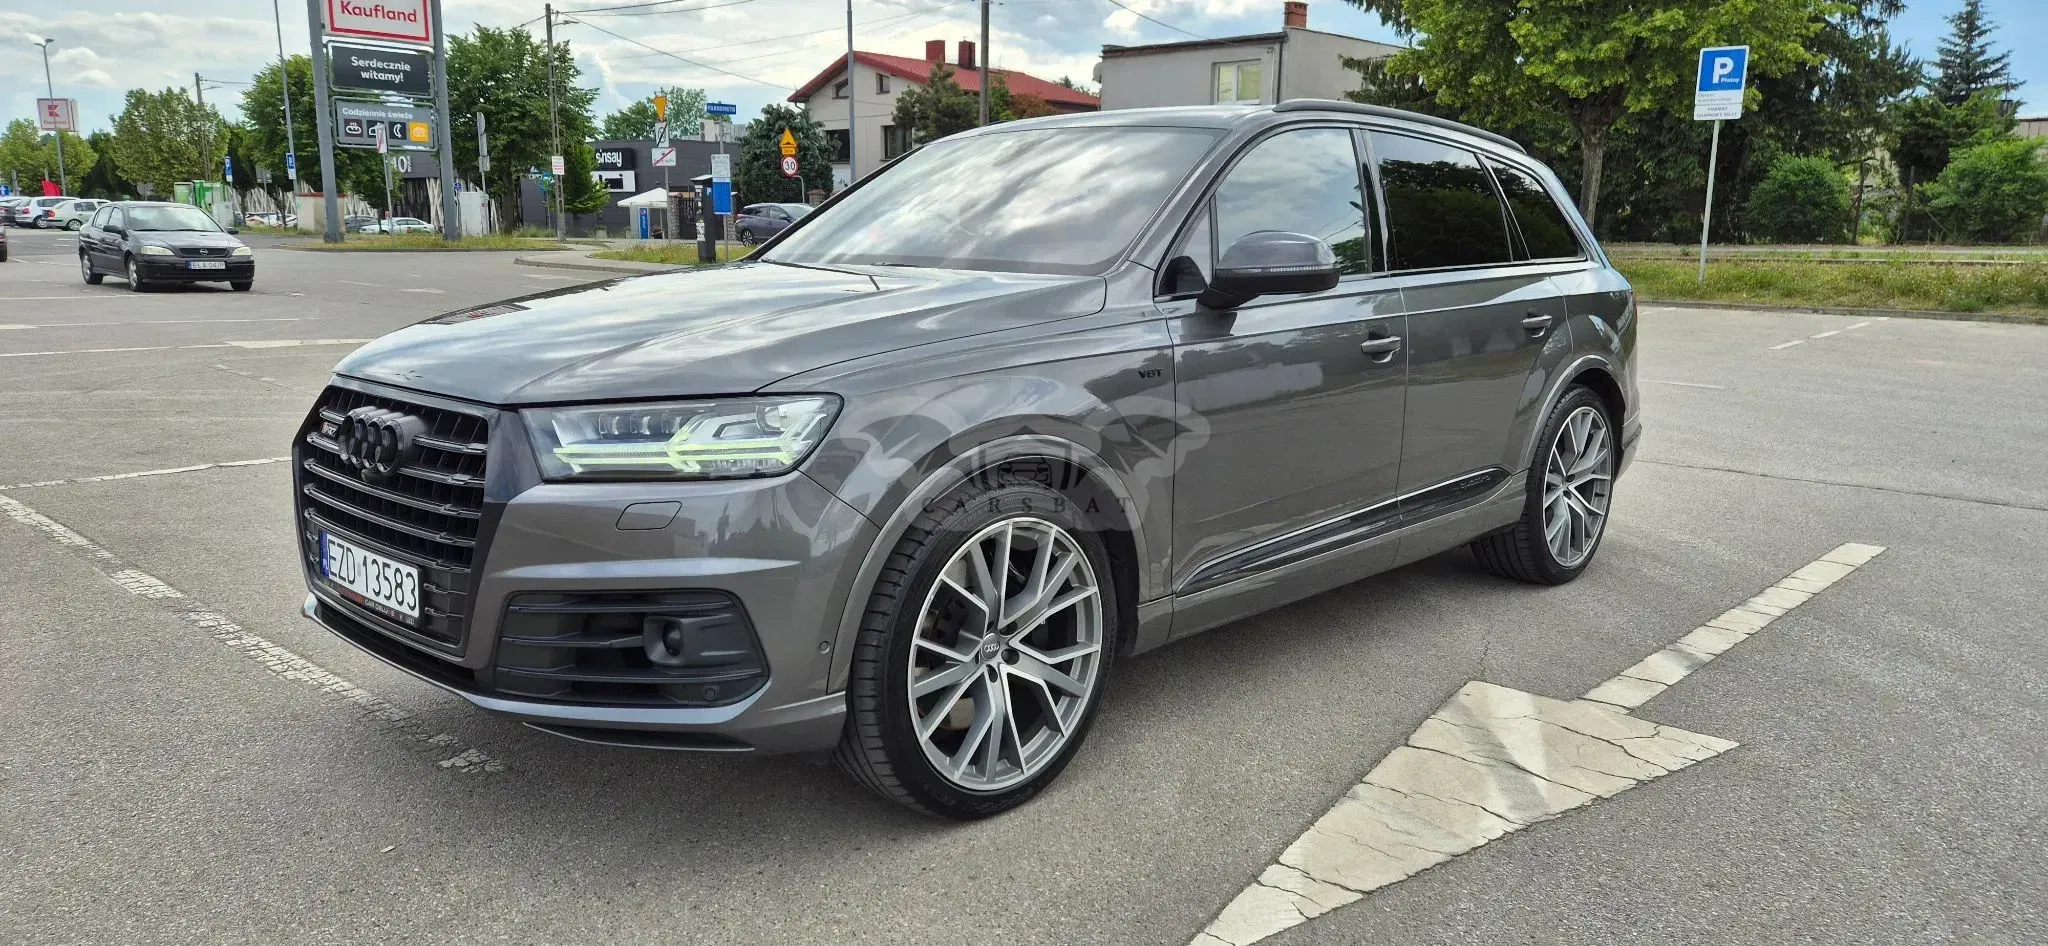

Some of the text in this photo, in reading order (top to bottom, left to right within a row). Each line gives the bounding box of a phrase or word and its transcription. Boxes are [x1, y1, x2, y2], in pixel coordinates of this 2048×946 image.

[341, 0, 417, 22] Kaufland
[351, 56, 411, 71] Serdecznie
[1713, 57, 1733, 83] P
[361, 69, 404, 83] witamy!
[595, 148, 623, 167] sinsay
[784, 160, 796, 171] 30
[328, 538, 356, 585] EZD
[362, 554, 417, 611] 13583
